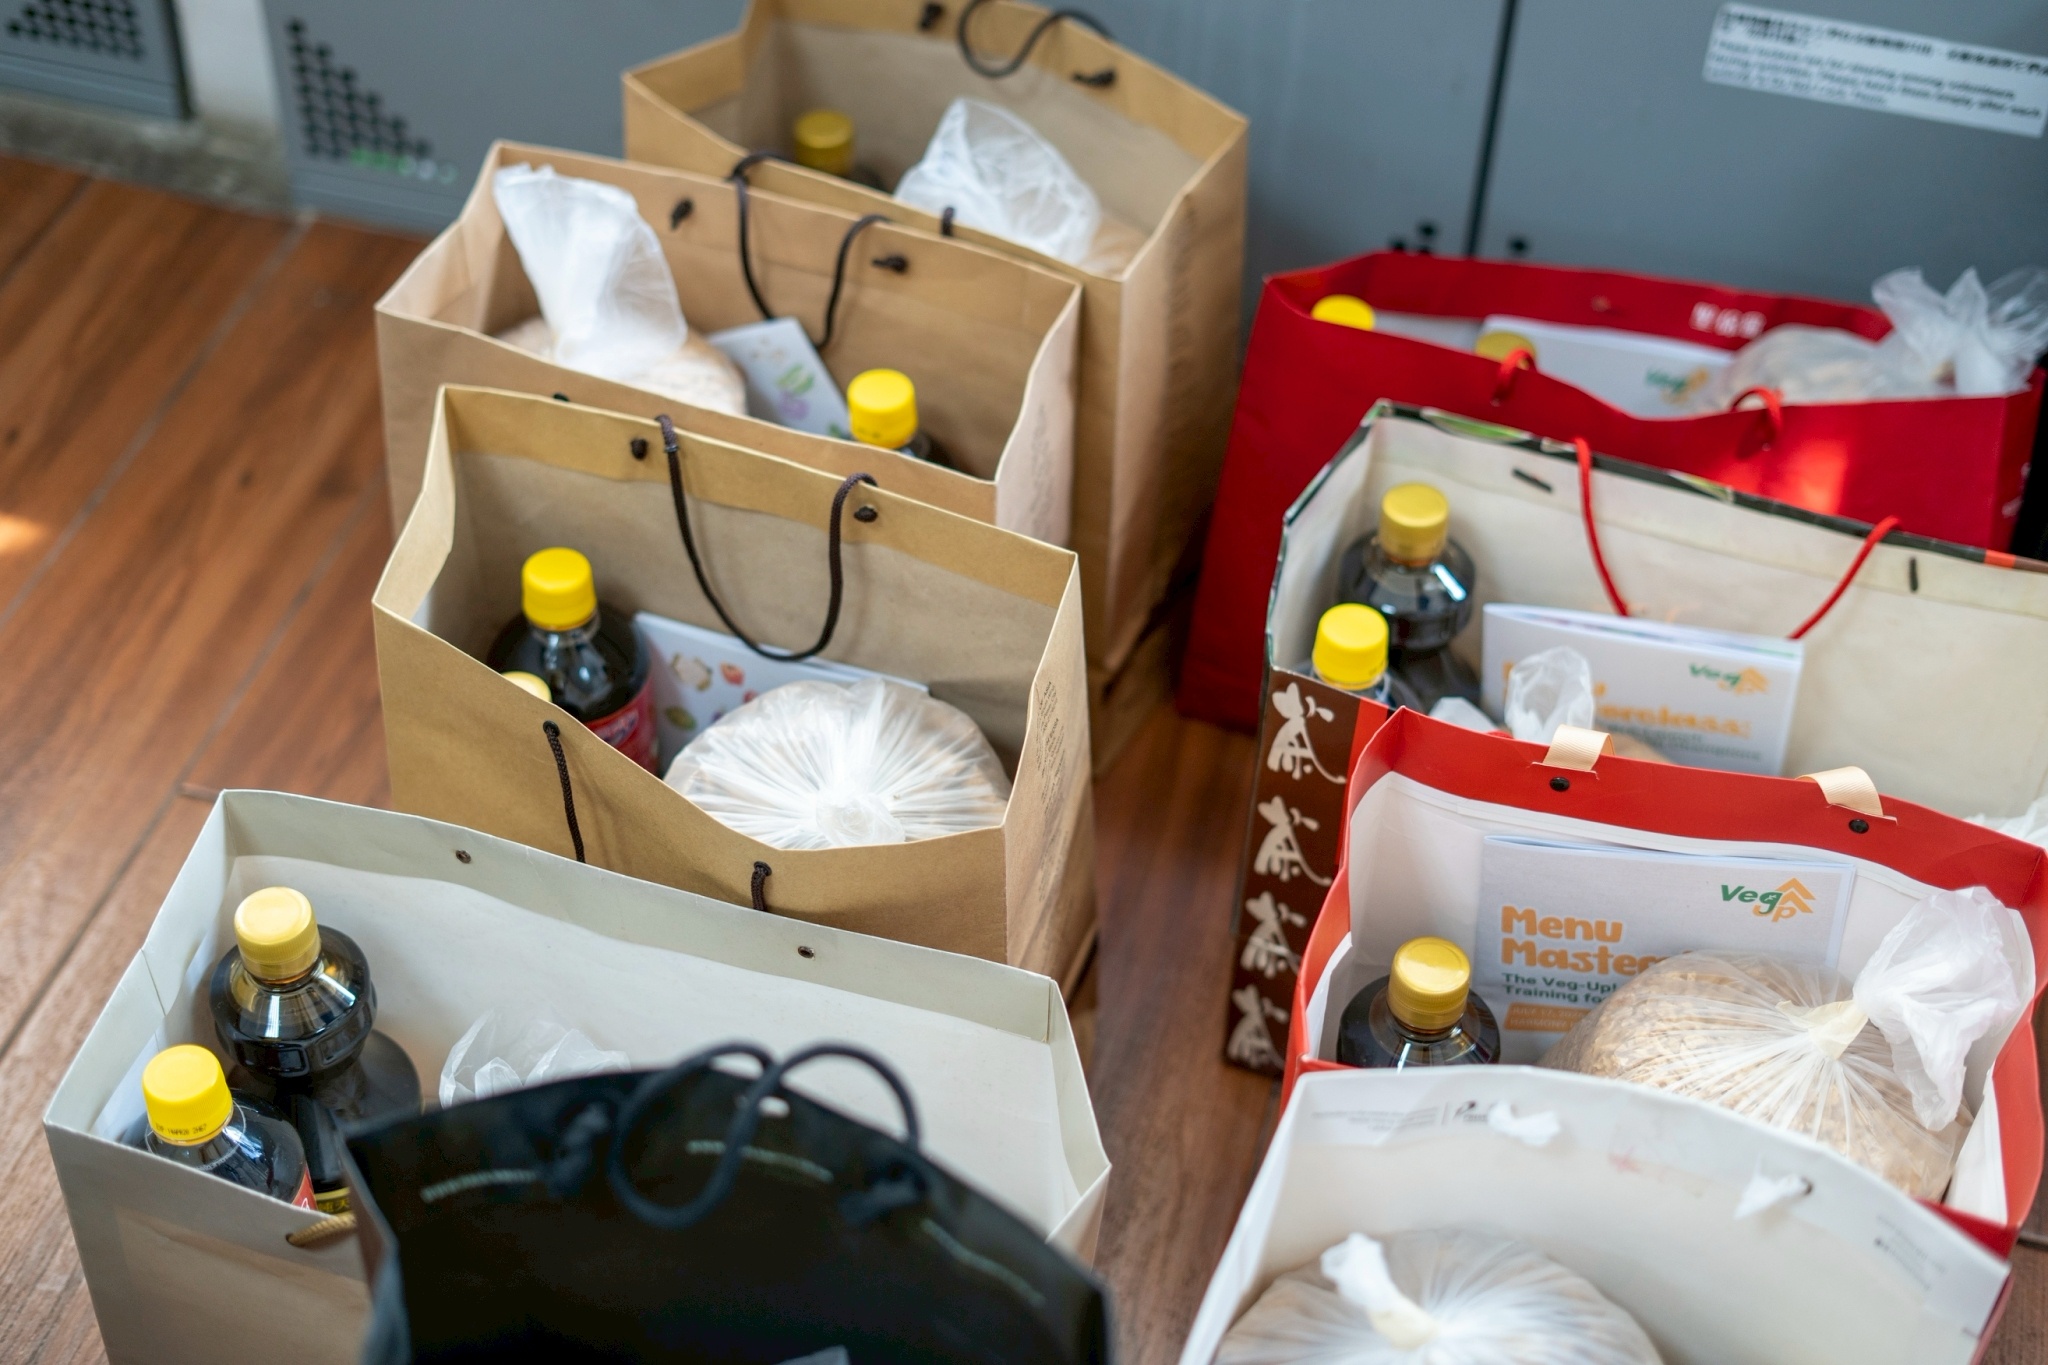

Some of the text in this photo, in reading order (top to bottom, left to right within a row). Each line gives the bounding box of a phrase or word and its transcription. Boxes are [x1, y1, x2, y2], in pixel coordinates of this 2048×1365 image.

[1721, 885, 1783, 915] Veg
[1501, 906, 1622, 943] Menu
[1501, 937, 1675, 976] Master
[1502, 973, 1537, 985] The
[1502, 984, 1578, 1003] Training
